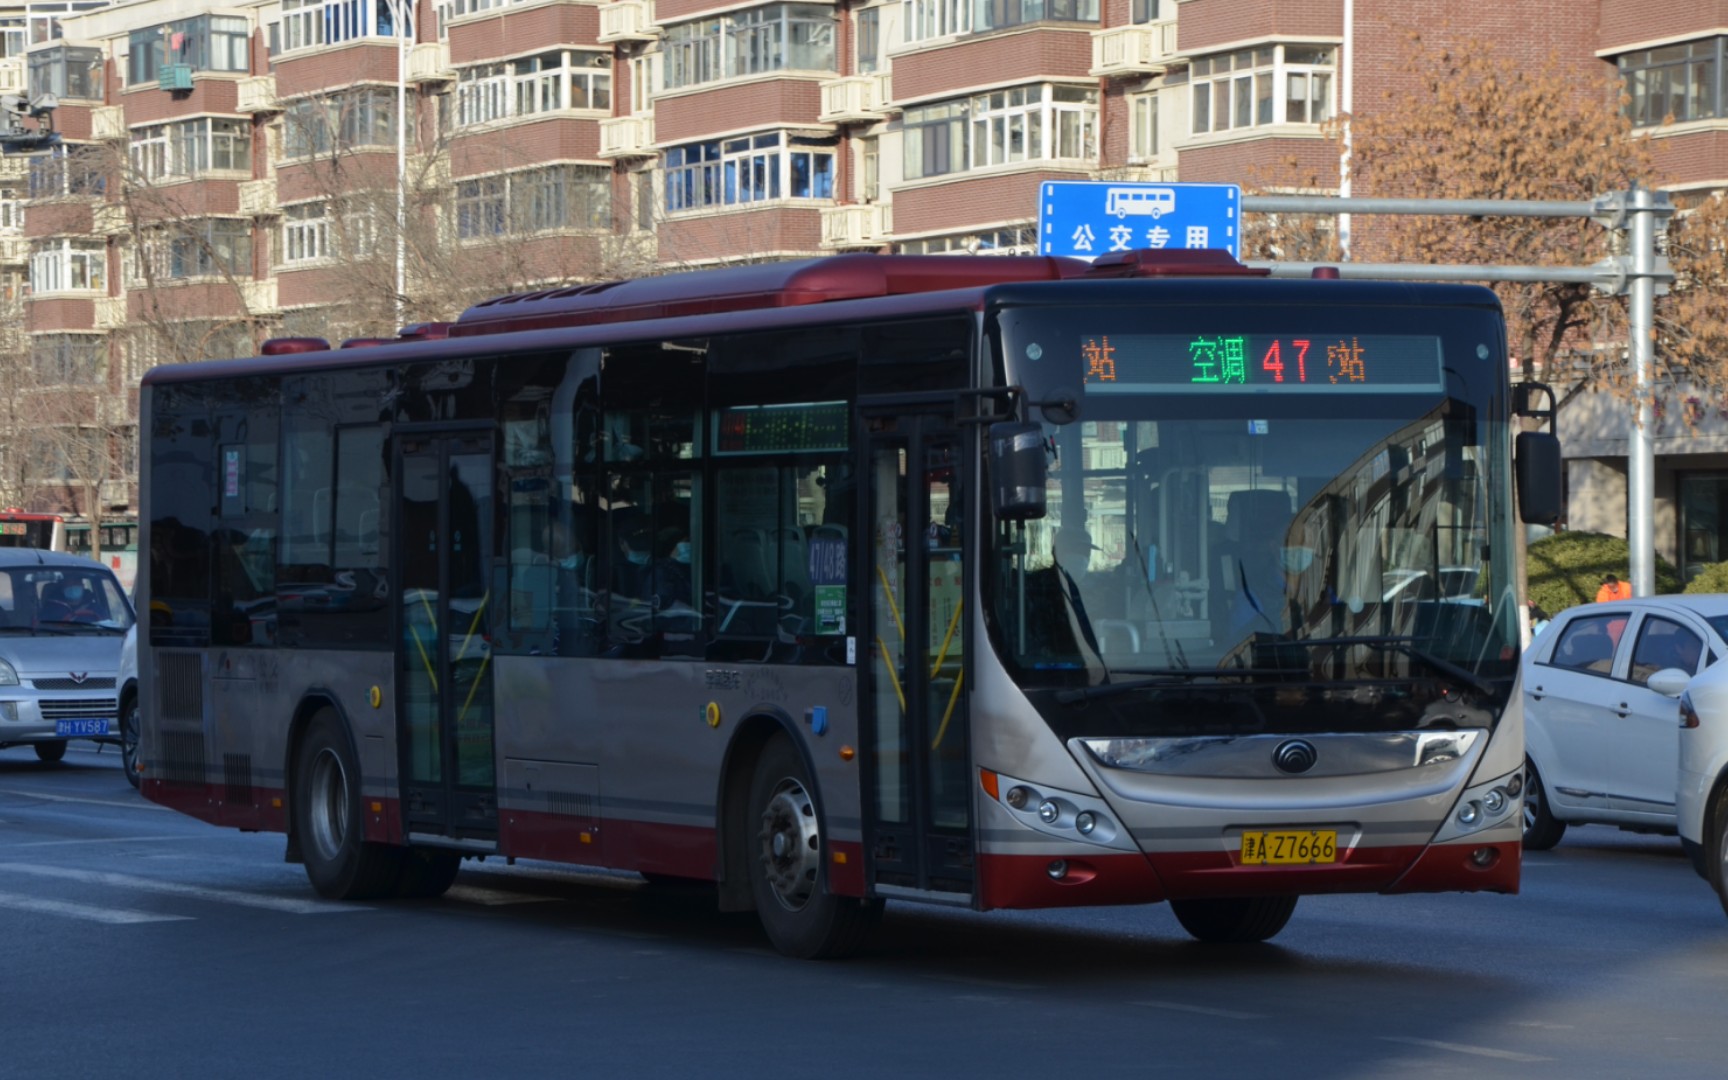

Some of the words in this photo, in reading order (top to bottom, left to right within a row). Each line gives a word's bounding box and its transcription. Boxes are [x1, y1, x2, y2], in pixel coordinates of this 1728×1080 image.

[1071, 223, 1209, 252] 公交专用
[1189, 336, 1245, 384] 空调
[1263, 339, 1311, 383] 47
